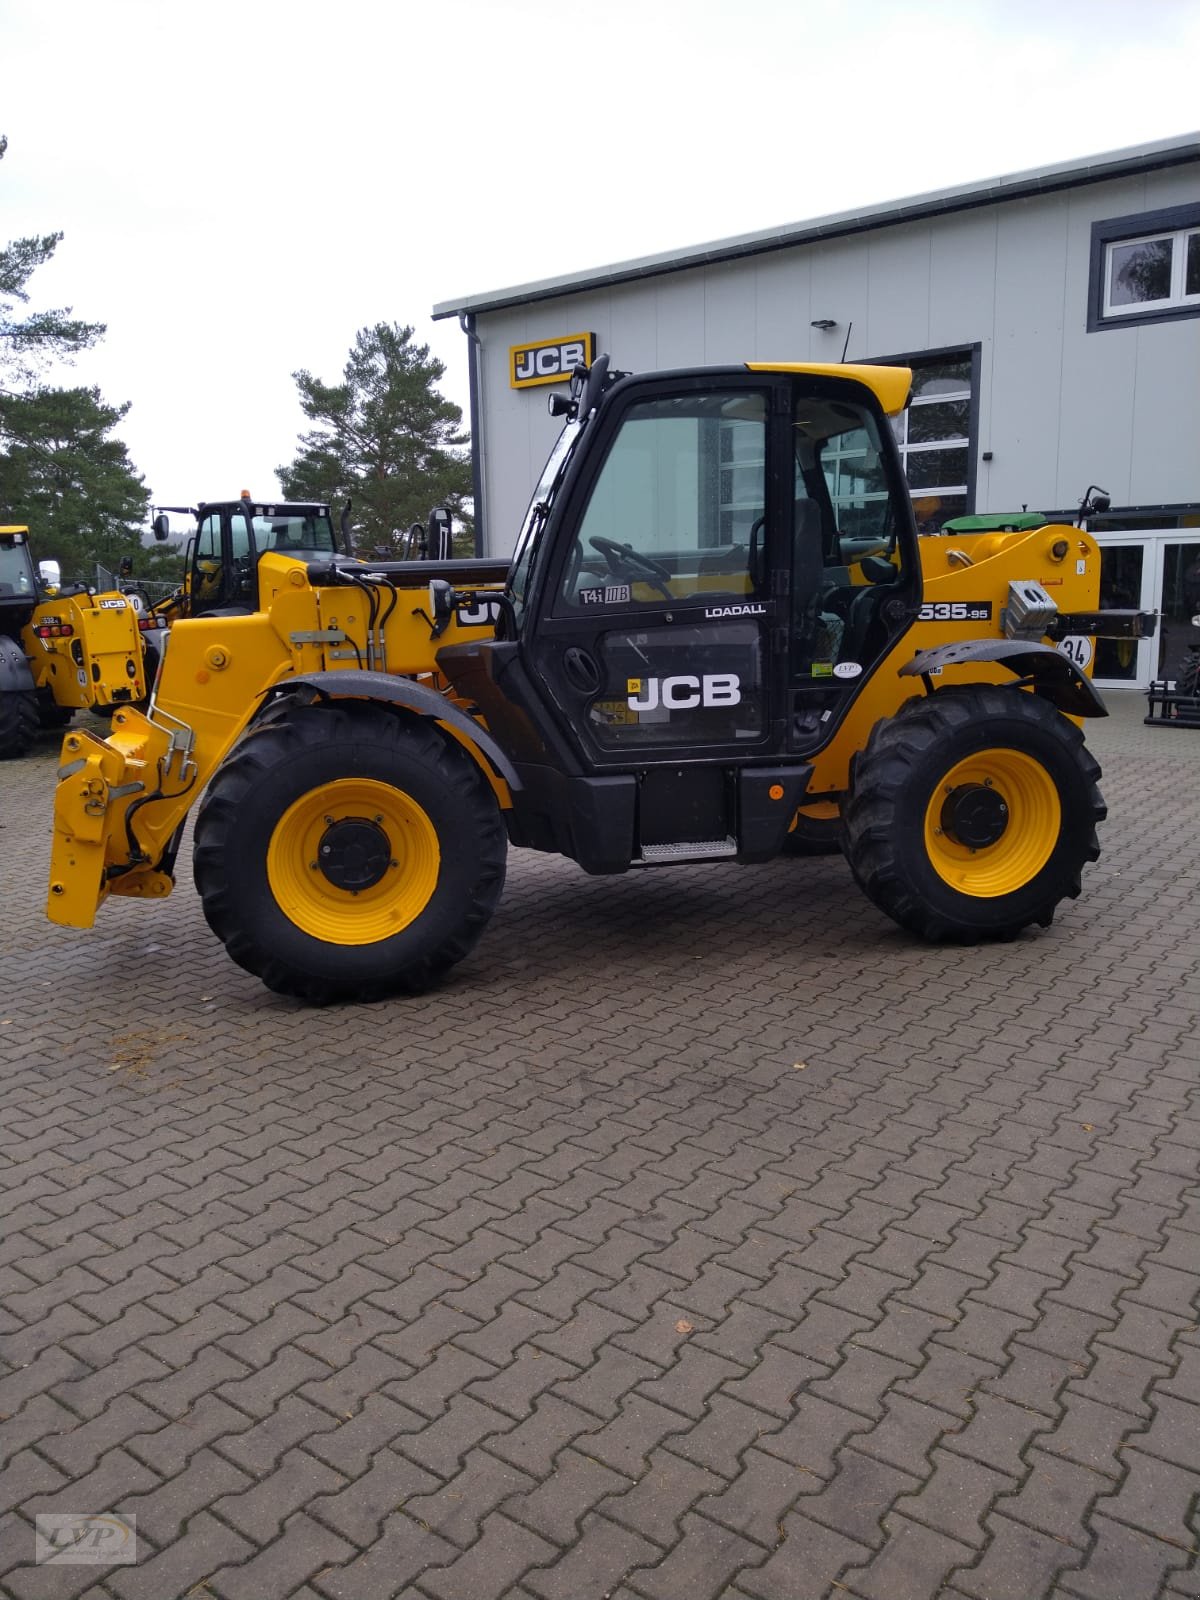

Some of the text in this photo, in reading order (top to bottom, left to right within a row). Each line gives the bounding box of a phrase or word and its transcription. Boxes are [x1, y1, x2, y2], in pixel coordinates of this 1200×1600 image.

[517, 343, 584, 378] JCB
[101, 600, 126, 608] JCB
[581, 589, 603, 604] T4i
[705, 604, 766, 618] LOADALL
[1063, 640, 1085, 665] 34
[627, 674, 741, 711] JCB
